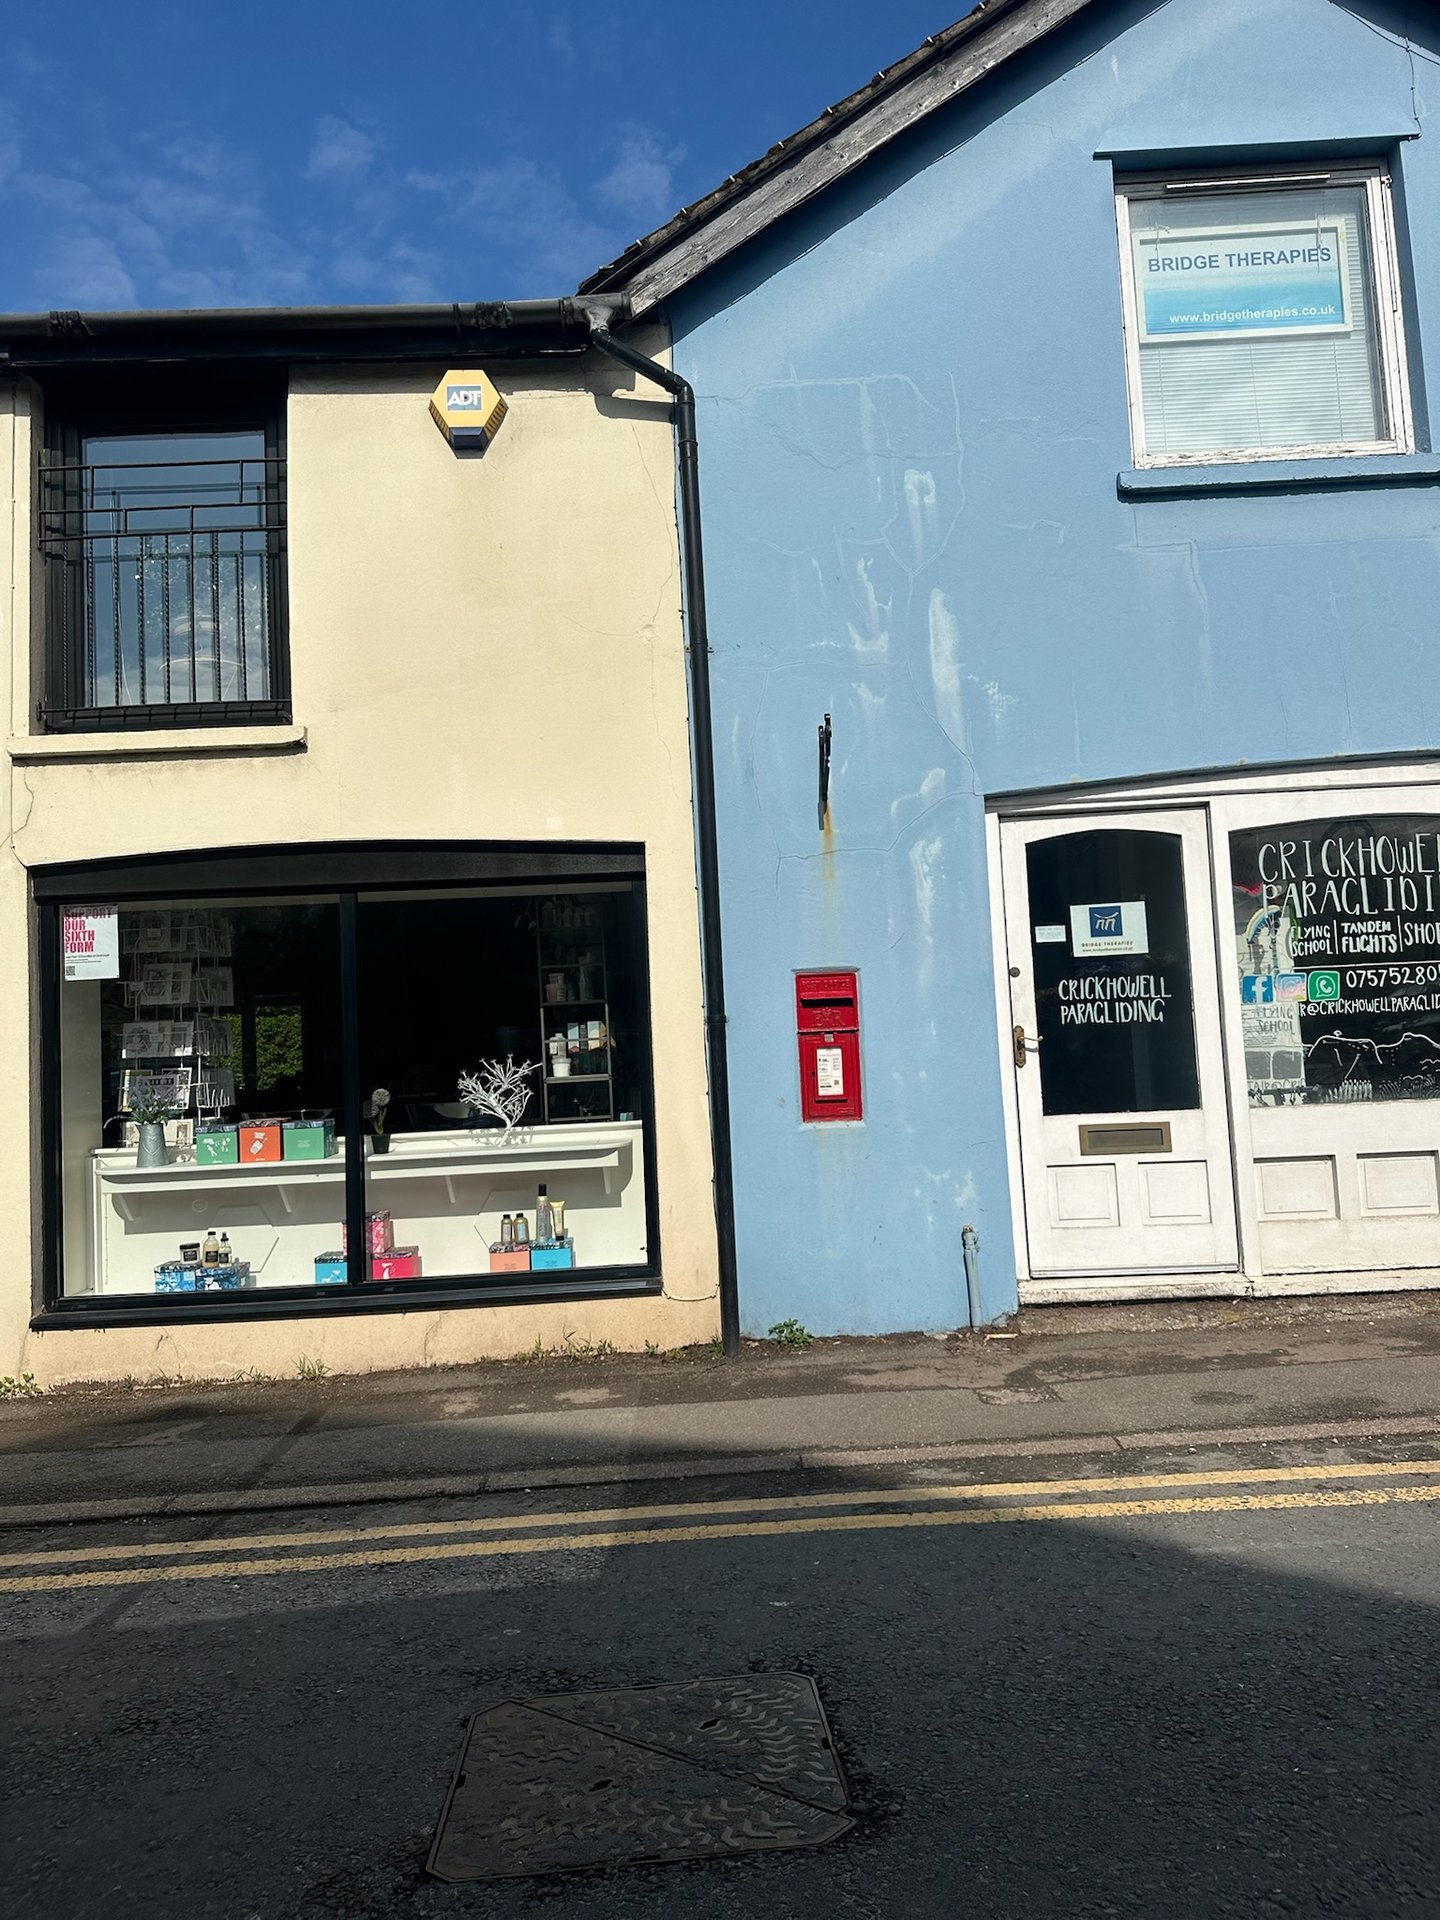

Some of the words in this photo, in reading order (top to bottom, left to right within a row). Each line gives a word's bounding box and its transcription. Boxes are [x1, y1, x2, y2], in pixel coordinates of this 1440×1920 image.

[1148, 254, 1220, 273] BRIDGE
[1224, 247, 1332, 268] THERAPIES
[1169, 304, 1336, 324] www.bridgetherapies.co.uk
[447, 390, 482, 406] ADT
[1258, 833, 1440, 883] CRICKHOWE
[1262, 873, 1440, 920] PARAGLIDI
[64, 907, 112, 919] SUPPORT
[64, 919, 86, 931] OUR
[1290, 925, 1331, 940] FLYING
[1340, 920, 1392, 934] TANDEM
[64, 930, 95, 942] SIXTH
[1341, 934, 1398, 953] FLIGHTS
[65, 941, 94, 953] FORM
[1290, 939, 1333, 957] SCHOOL
[801, 980, 821, 990] POST
[823, 979, 851, 990] OFFICE
[1345, 964, 1440, 988] 07575280
[1058, 975, 1172, 1001] CRICKHOWELL
[1060, 998, 1165, 1025] PARAGLIDING
